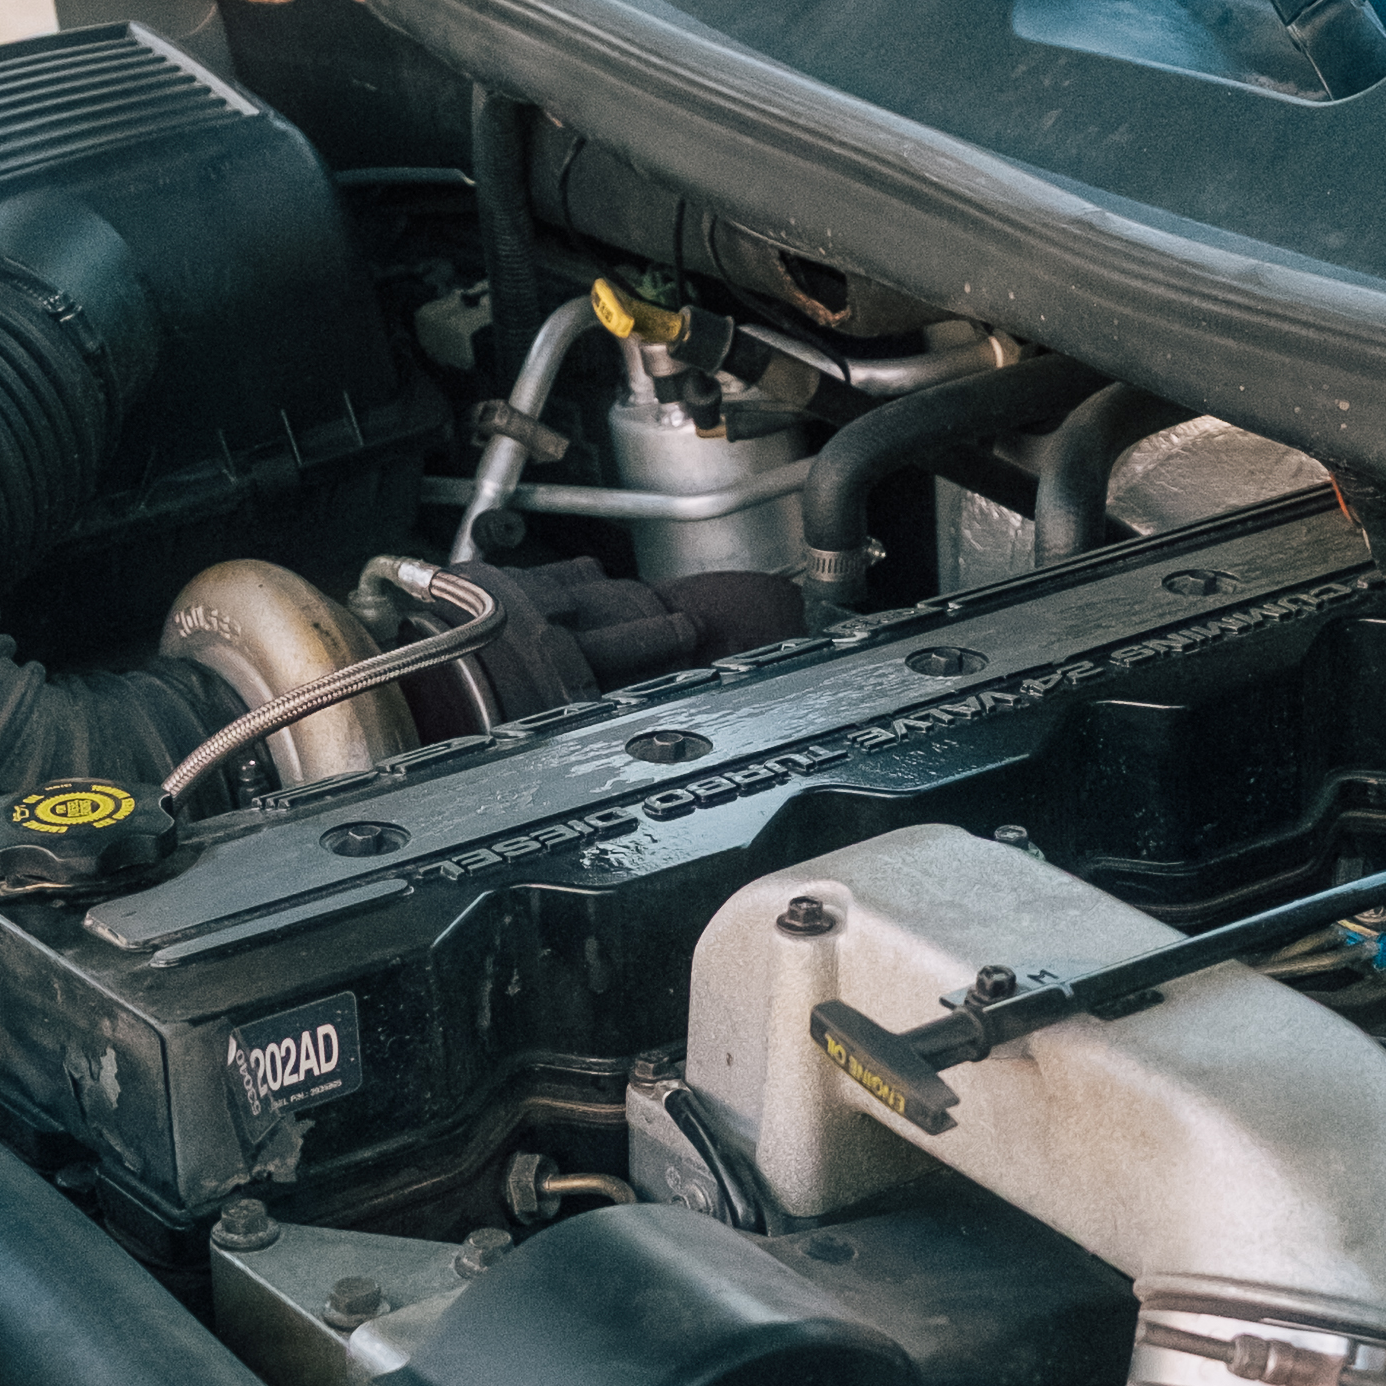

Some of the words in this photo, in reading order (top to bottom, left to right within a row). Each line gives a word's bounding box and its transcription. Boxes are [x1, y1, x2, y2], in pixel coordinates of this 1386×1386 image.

[1109, 582, 1354, 667] CUMMINS
[1020, 660, 1105, 698] 24
[846, 690, 1023, 754] VALVE
[641, 745, 852, 822] TURBO
[417, 806, 641, 880] DIESEL
[250, 1023, 339, 1098] 202AD
